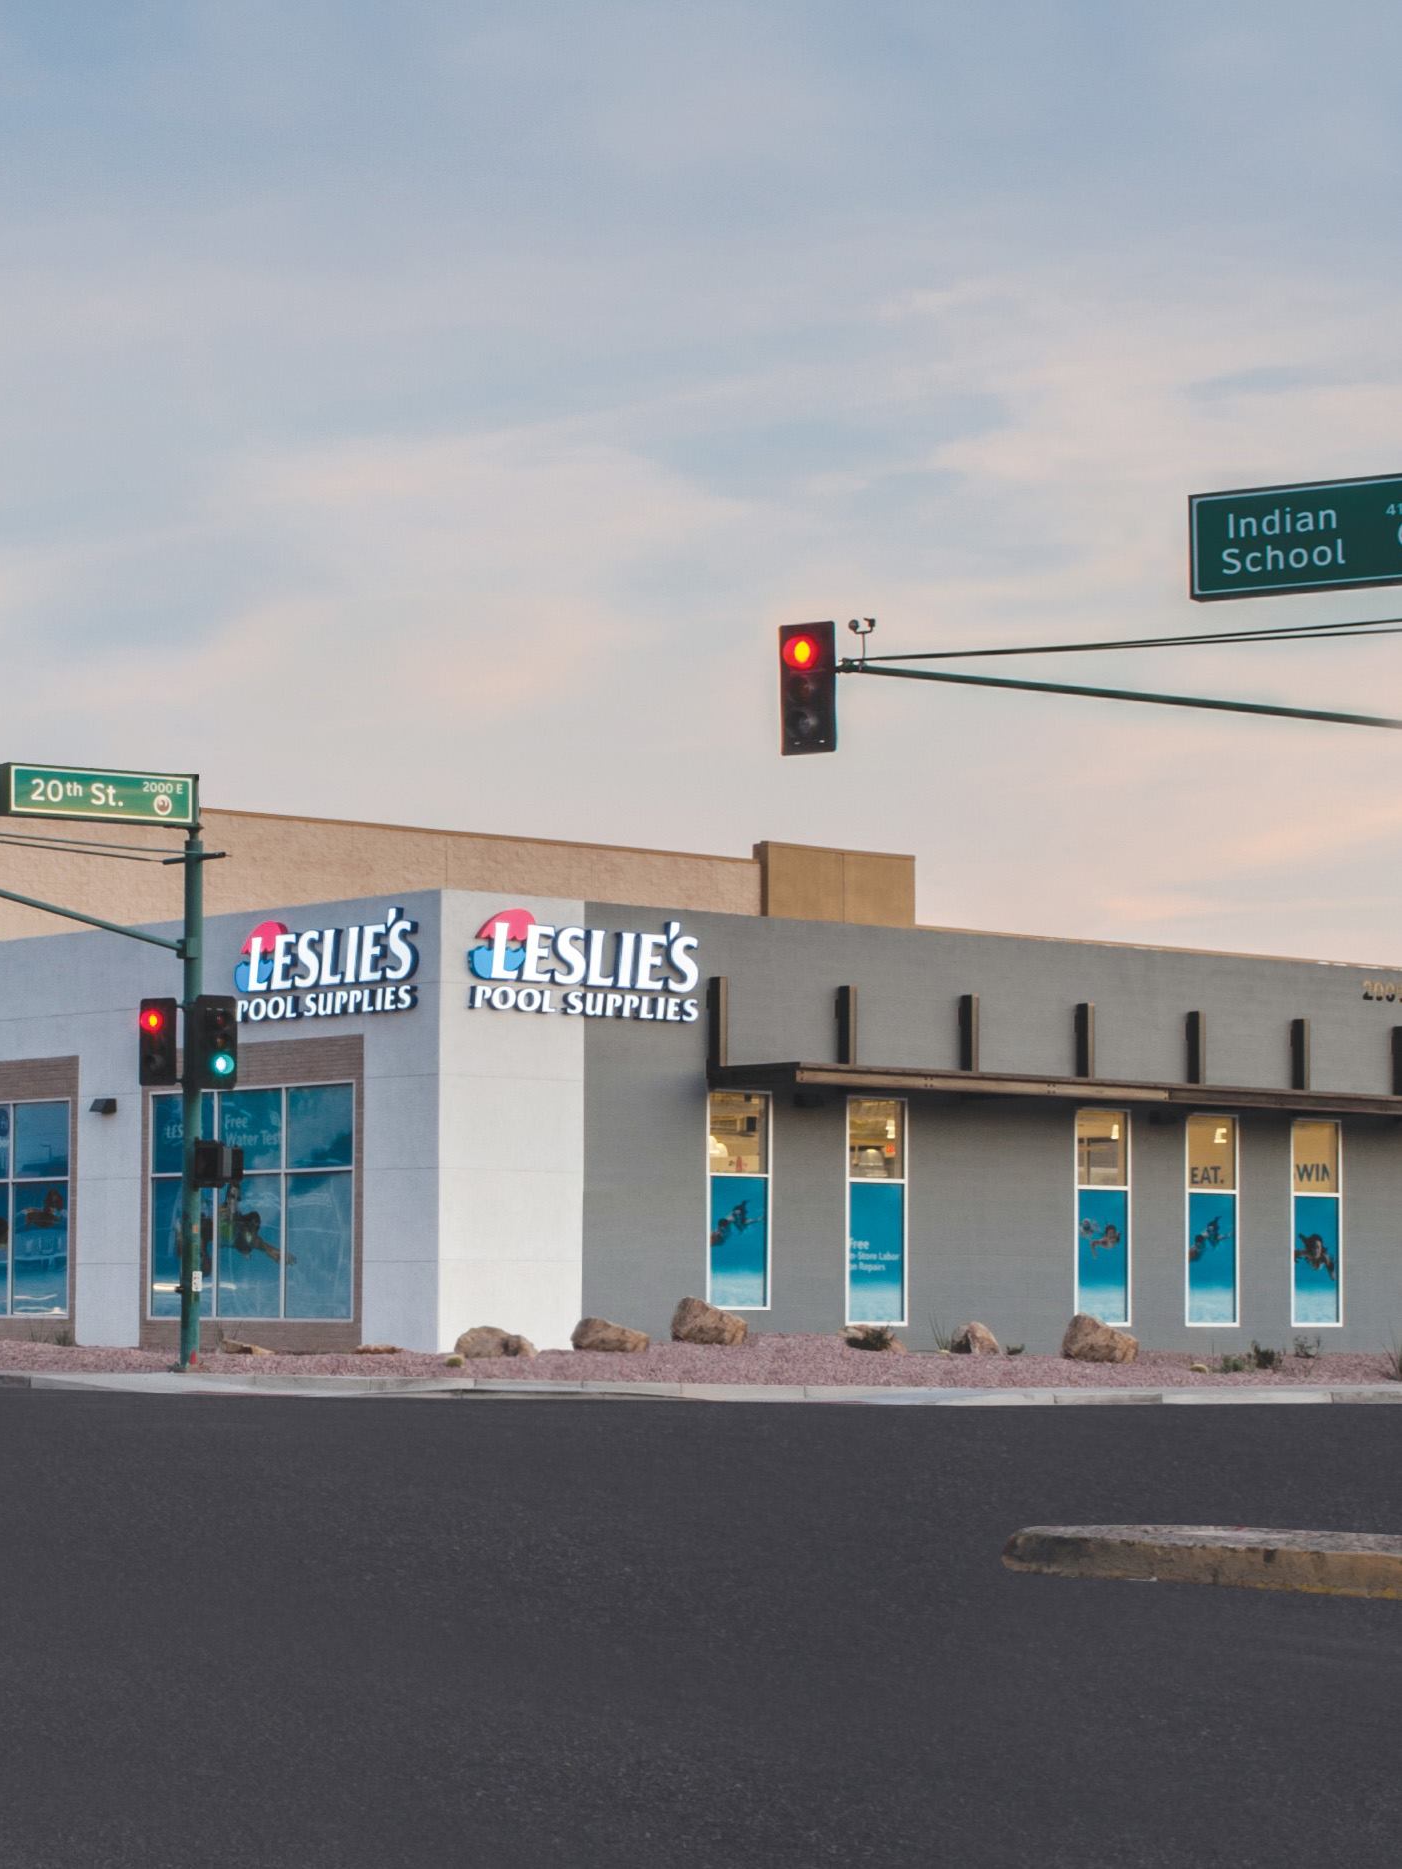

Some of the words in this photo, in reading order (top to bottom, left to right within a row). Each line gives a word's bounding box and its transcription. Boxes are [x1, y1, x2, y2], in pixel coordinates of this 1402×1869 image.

[1227, 507, 1337, 539] Indian
[1221, 538, 1346, 575] School
[30, 778, 83, 803] 20th
[91, 783, 124, 808] St.
[142, 781, 174, 794] 2000
[176, 783, 183, 795] E
[248, 907, 413, 992] LESLIE'S
[491, 921, 699, 993] LESLIE'S
[236, 995, 297, 1023] POOL
[304, 985, 412, 1017] SUPPLIES
[474, 985, 557, 1013] POOL
[565, 991, 699, 1022] SUPPLIES
[225, 1114, 248, 1130] Free
[226, 1131, 257, 1147] Water
